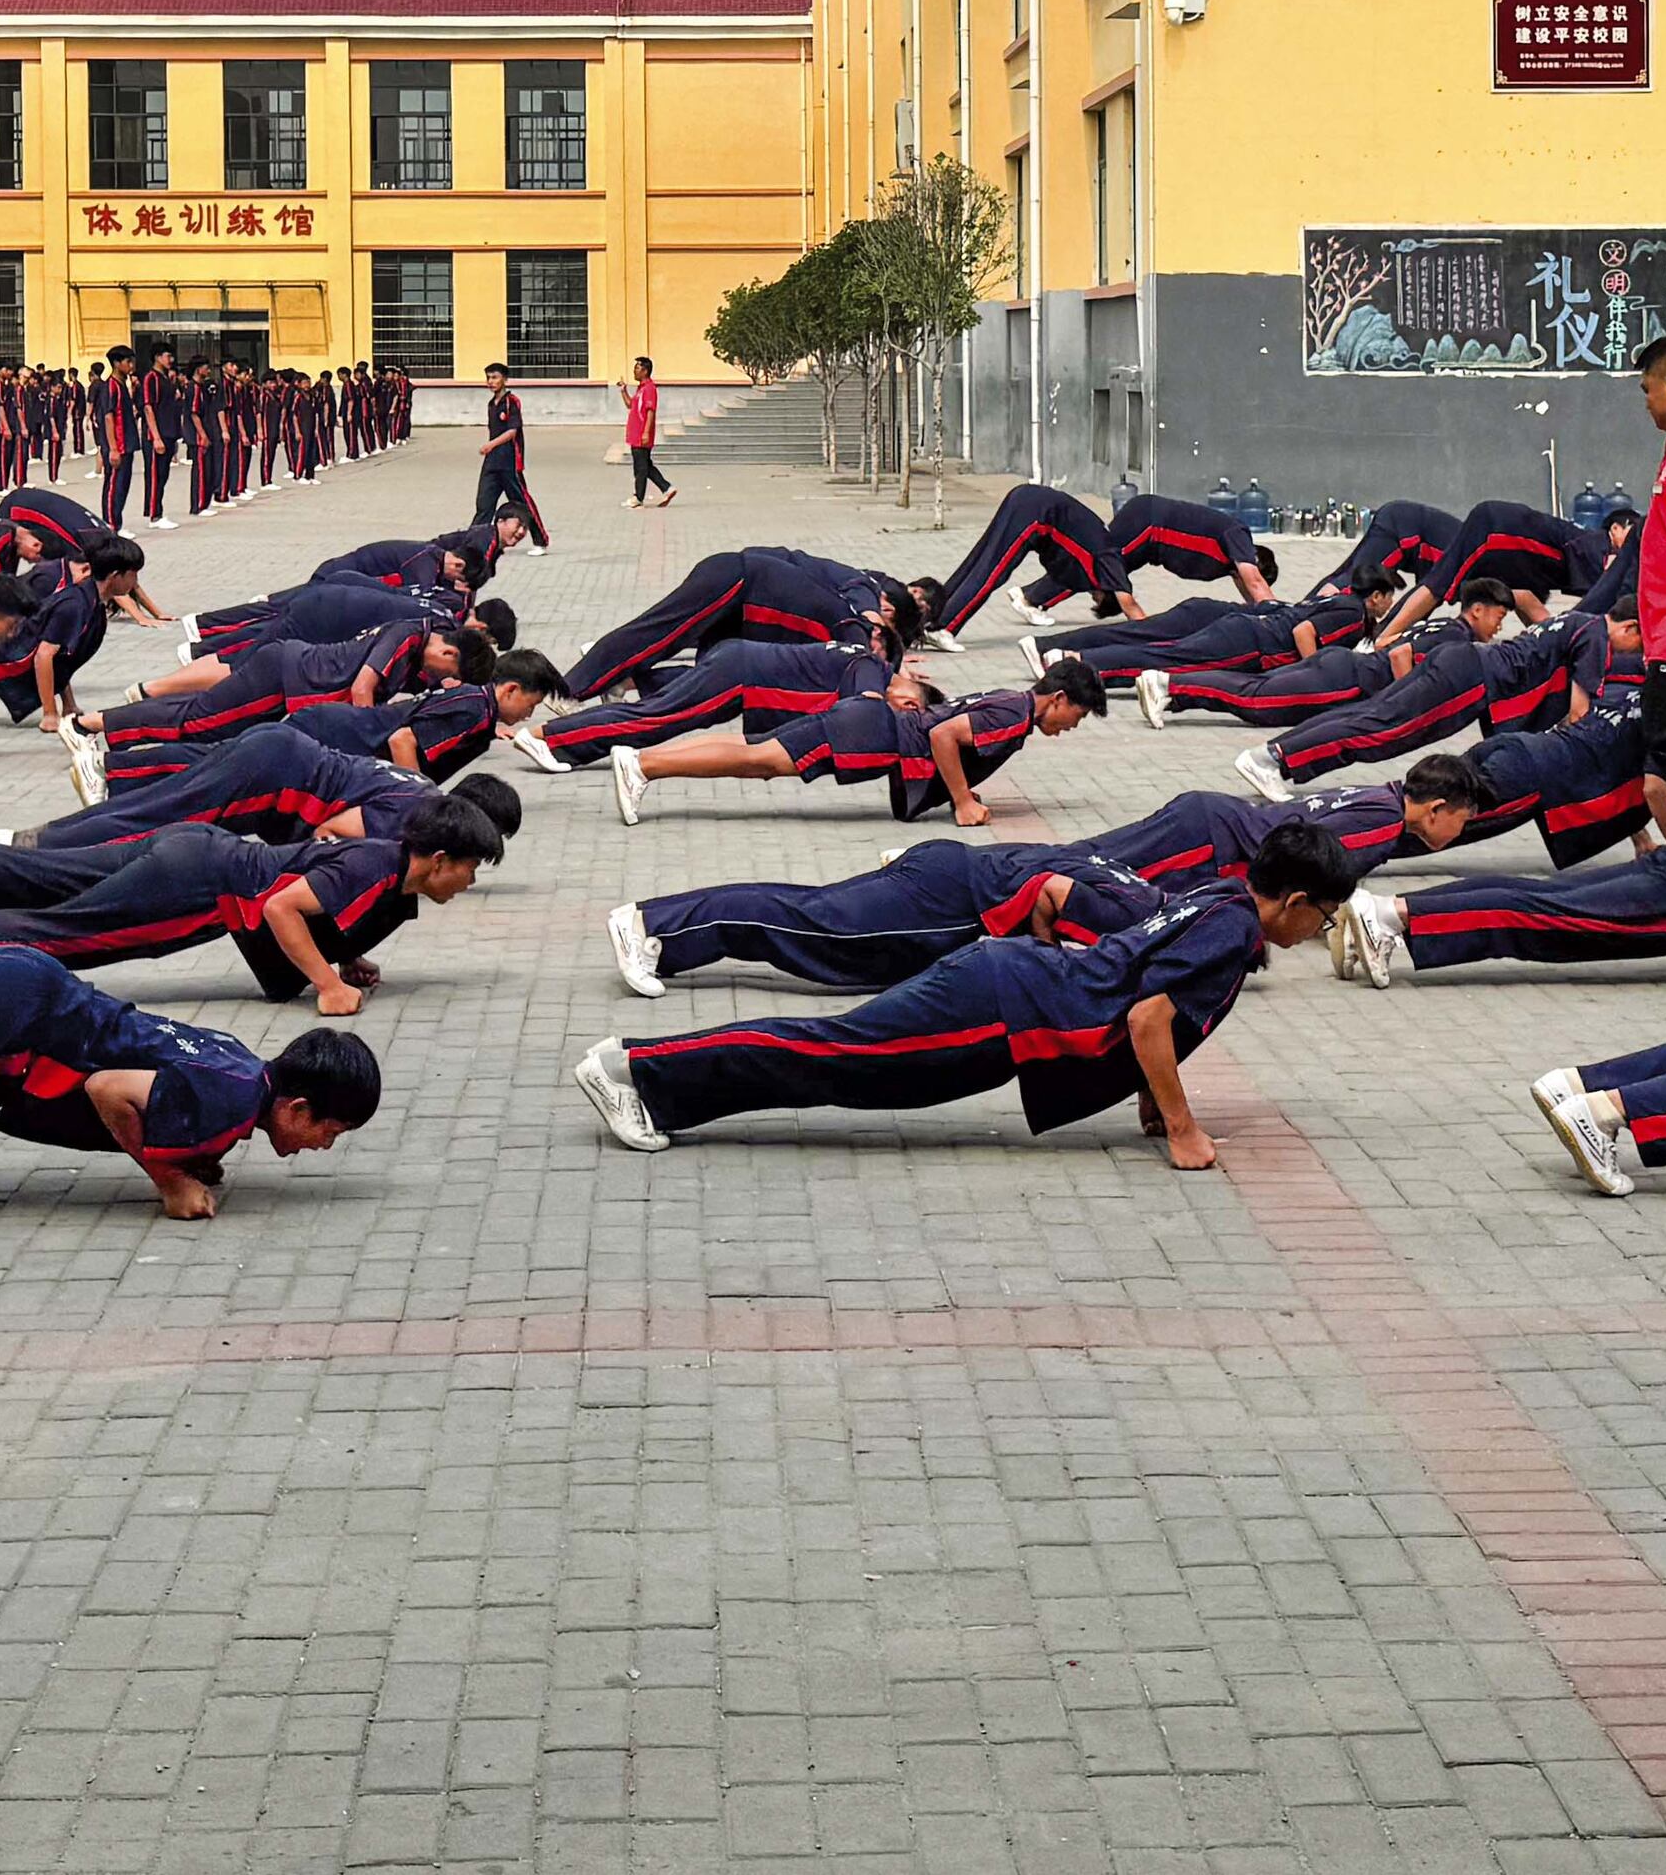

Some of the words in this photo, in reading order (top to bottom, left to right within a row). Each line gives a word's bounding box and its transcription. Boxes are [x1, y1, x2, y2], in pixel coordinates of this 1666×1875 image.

[1515, 5, 1628, 22] 树立安全意识
[1515, 27, 1628, 43] 建设平安校园
[82, 203, 314, 237] 体能训练馆
[1525, 252, 1606, 368] 礼仪
